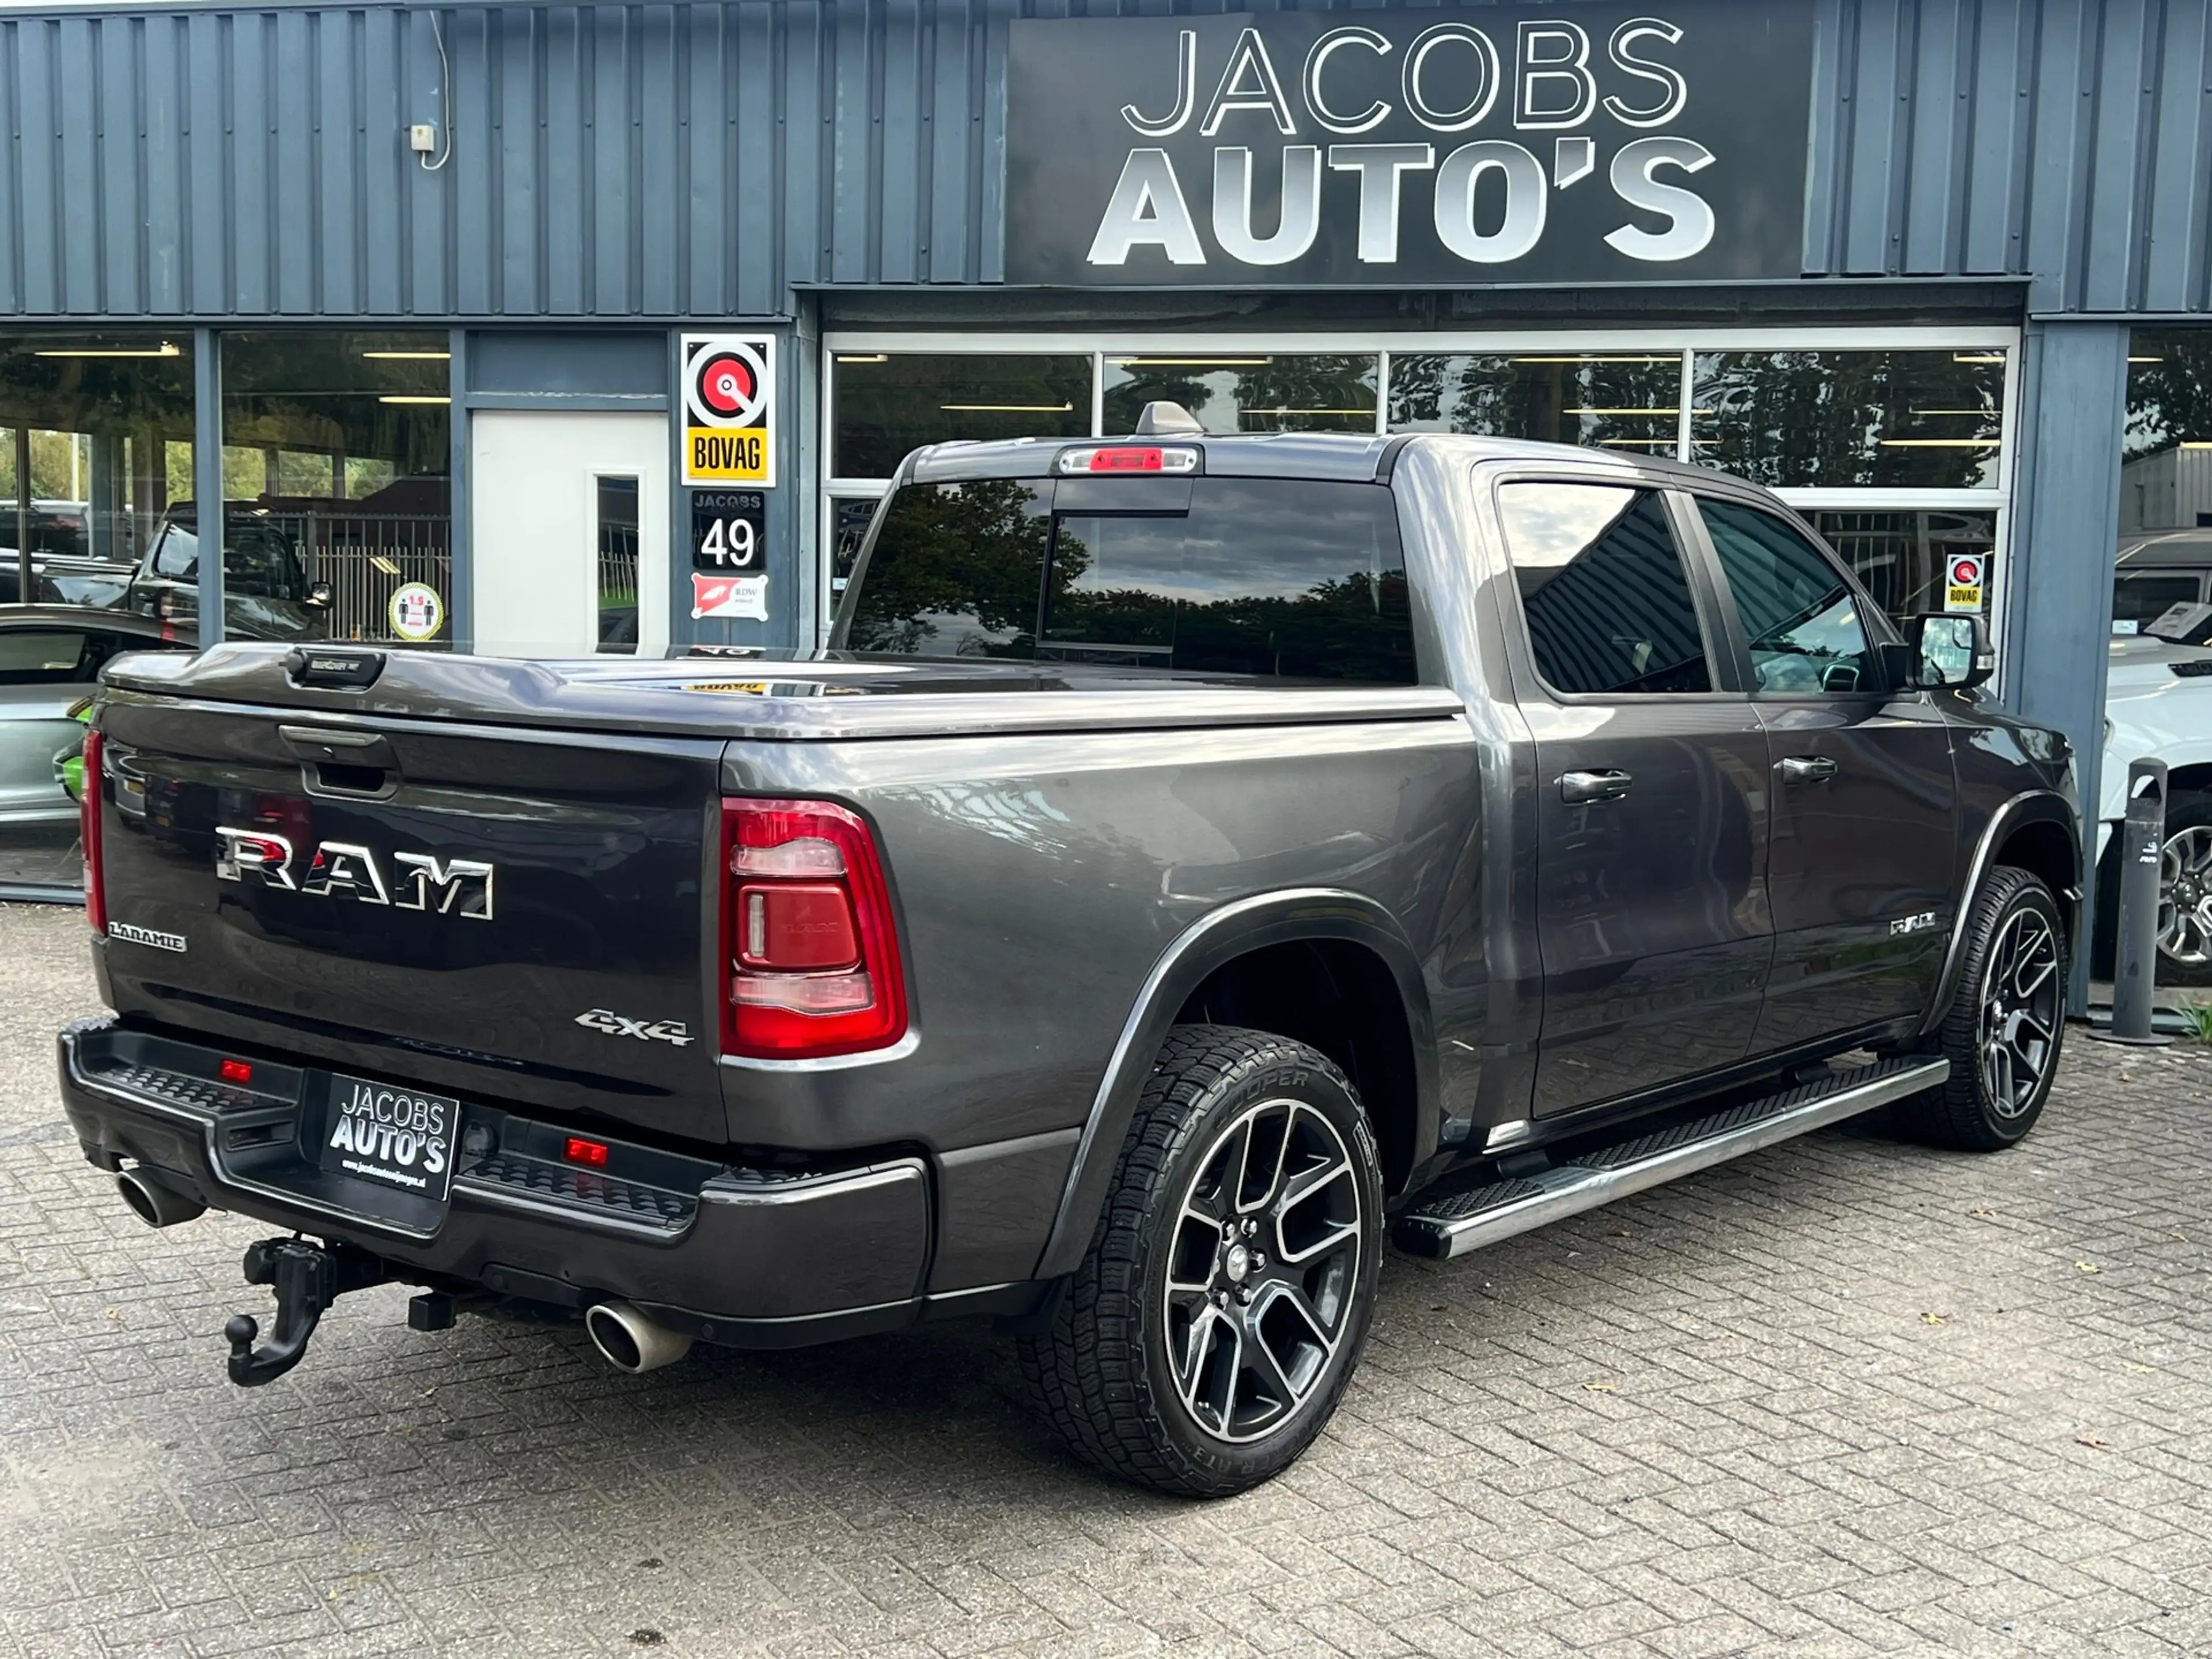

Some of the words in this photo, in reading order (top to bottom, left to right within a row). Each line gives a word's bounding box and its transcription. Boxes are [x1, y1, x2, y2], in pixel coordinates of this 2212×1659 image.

[1121, 17, 1688, 136] JACOBS
[1086, 137, 1716, 264] AUTO'S
[694, 436, 760, 470] BOVAG
[695, 494, 761, 509] JACOBS
[701, 518, 754, 566] 49
[735, 588, 758, 596] RDW
[1950, 589, 1978, 603] BOVAG
[215, 827, 493, 921] RAM
[109, 922, 185, 951] LARAMIE
[341, 1084, 444, 1135] JACOBS
[329, 1115, 446, 1173] AUTO'S
